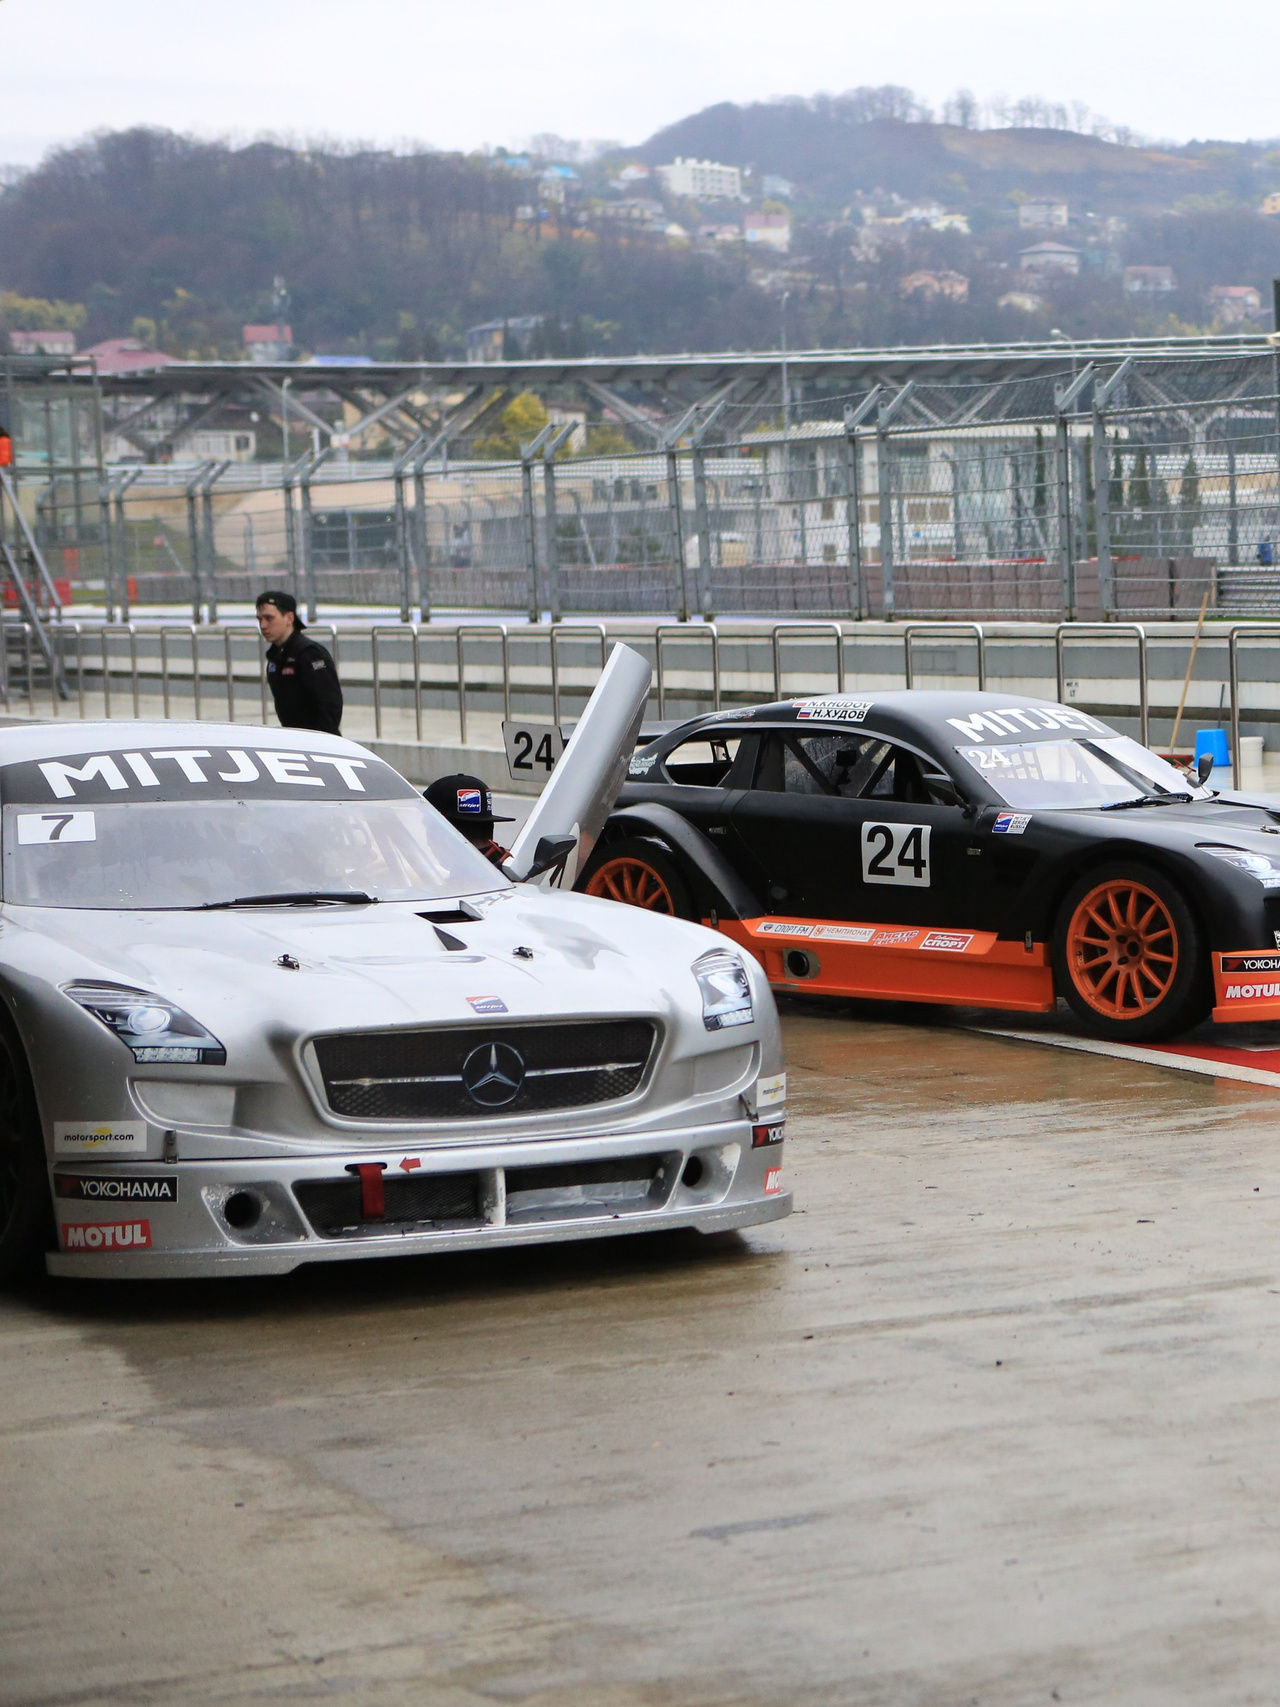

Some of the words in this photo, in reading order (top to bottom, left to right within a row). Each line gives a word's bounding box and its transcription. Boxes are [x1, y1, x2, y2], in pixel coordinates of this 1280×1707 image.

[812, 709, 866, 720] Н.ХУДОВ
[945, 708, 1106, 743] MITJET
[513, 731, 555, 772] 24
[967, 747, 1013, 769] 24
[38, 750, 368, 799] MITJET
[41, 814, 74, 841] 7
[867, 825, 926, 878] 24
[924, 939, 965, 948] СПОРТ
[64, 1133, 134, 1142] motorsport.com
[80, 1181, 171, 1197] YOKOHAMA
[67, 1224, 147, 1247] MOTUL
